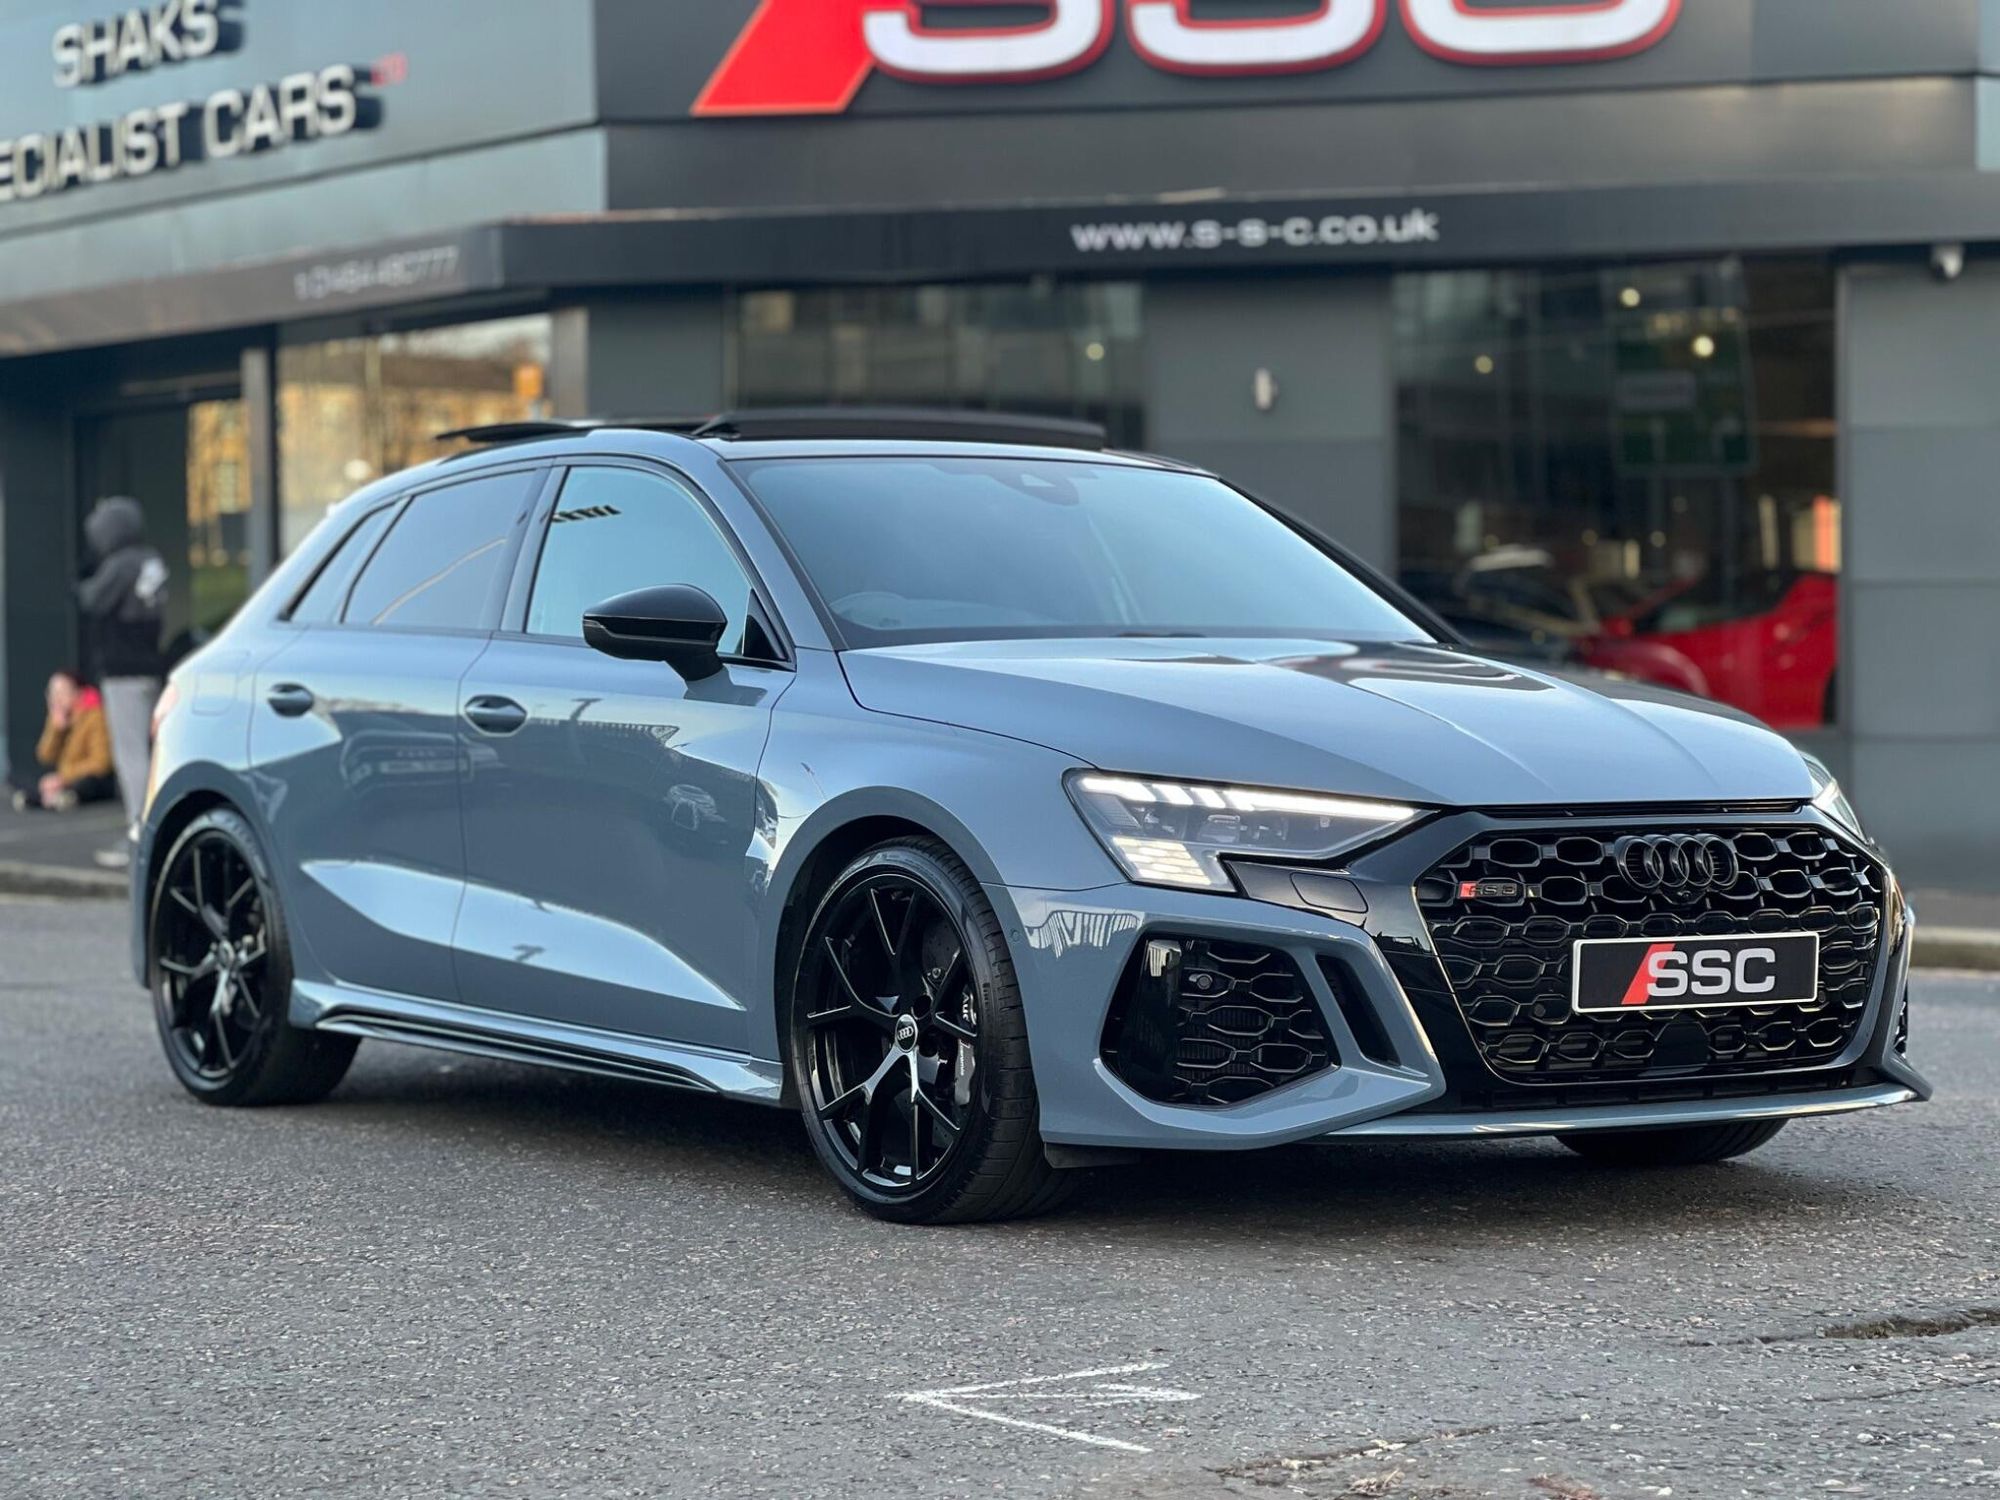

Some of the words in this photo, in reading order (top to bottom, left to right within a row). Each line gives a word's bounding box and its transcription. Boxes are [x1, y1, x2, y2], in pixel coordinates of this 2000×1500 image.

[52, 0, 219, 88] SHAKS
[204, 64, 357, 159] CARS
[1071, 207, 1440, 251] www.s-s-c.co.uk
[1647, 947, 1776, 997] SSC
